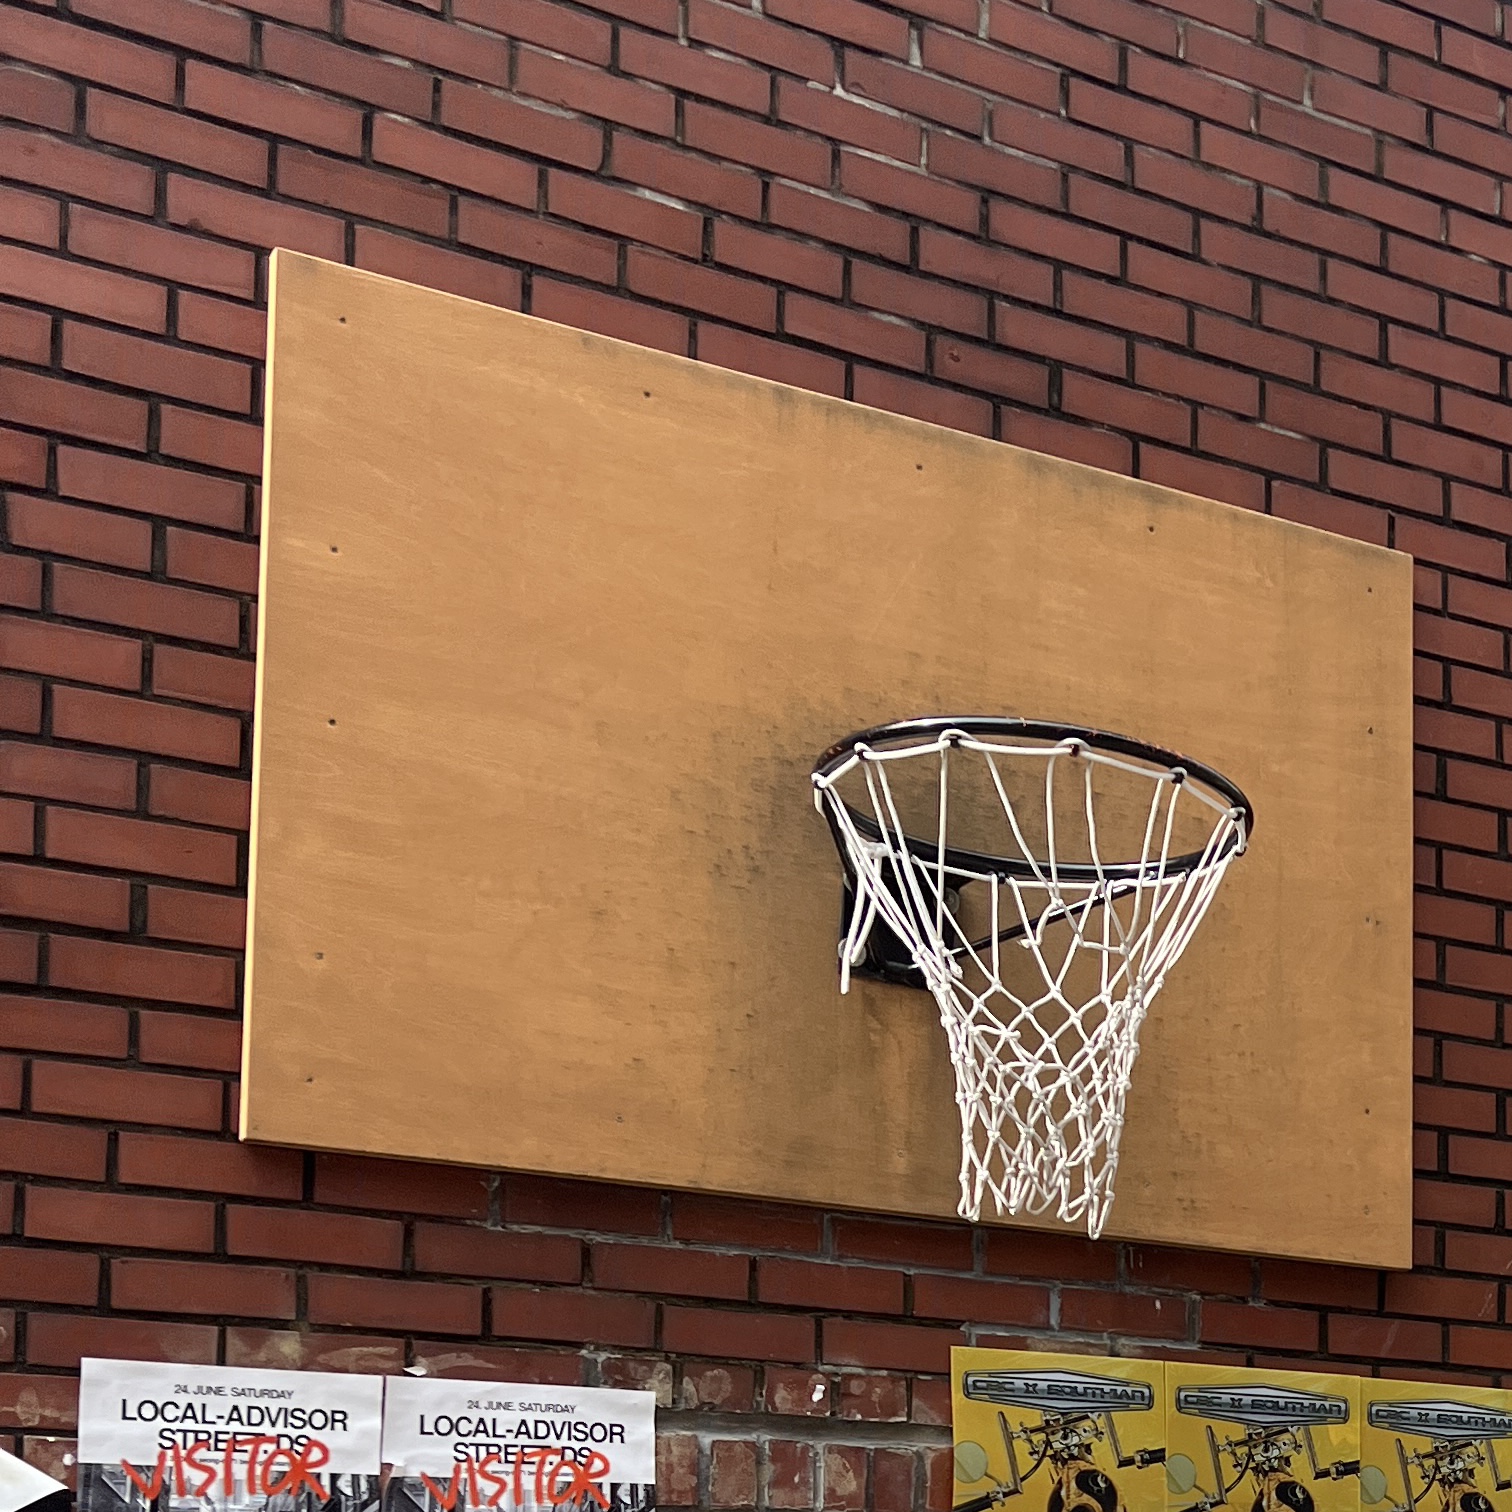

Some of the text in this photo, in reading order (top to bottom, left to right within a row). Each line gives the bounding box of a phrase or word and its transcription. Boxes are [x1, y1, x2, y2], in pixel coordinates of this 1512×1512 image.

[231, 1387, 294, 1400] SATURDAY
[519, 1402, 576, 1414] SATURDAY
[121, 1399, 348, 1431] LOCAL-ADVISOR
[420, 1414, 625, 1443] LOCAL-ADVISOR
[121, 1437, 330, 1503] VISITOR
[421, 1447, 611, 1511] VISITOR
